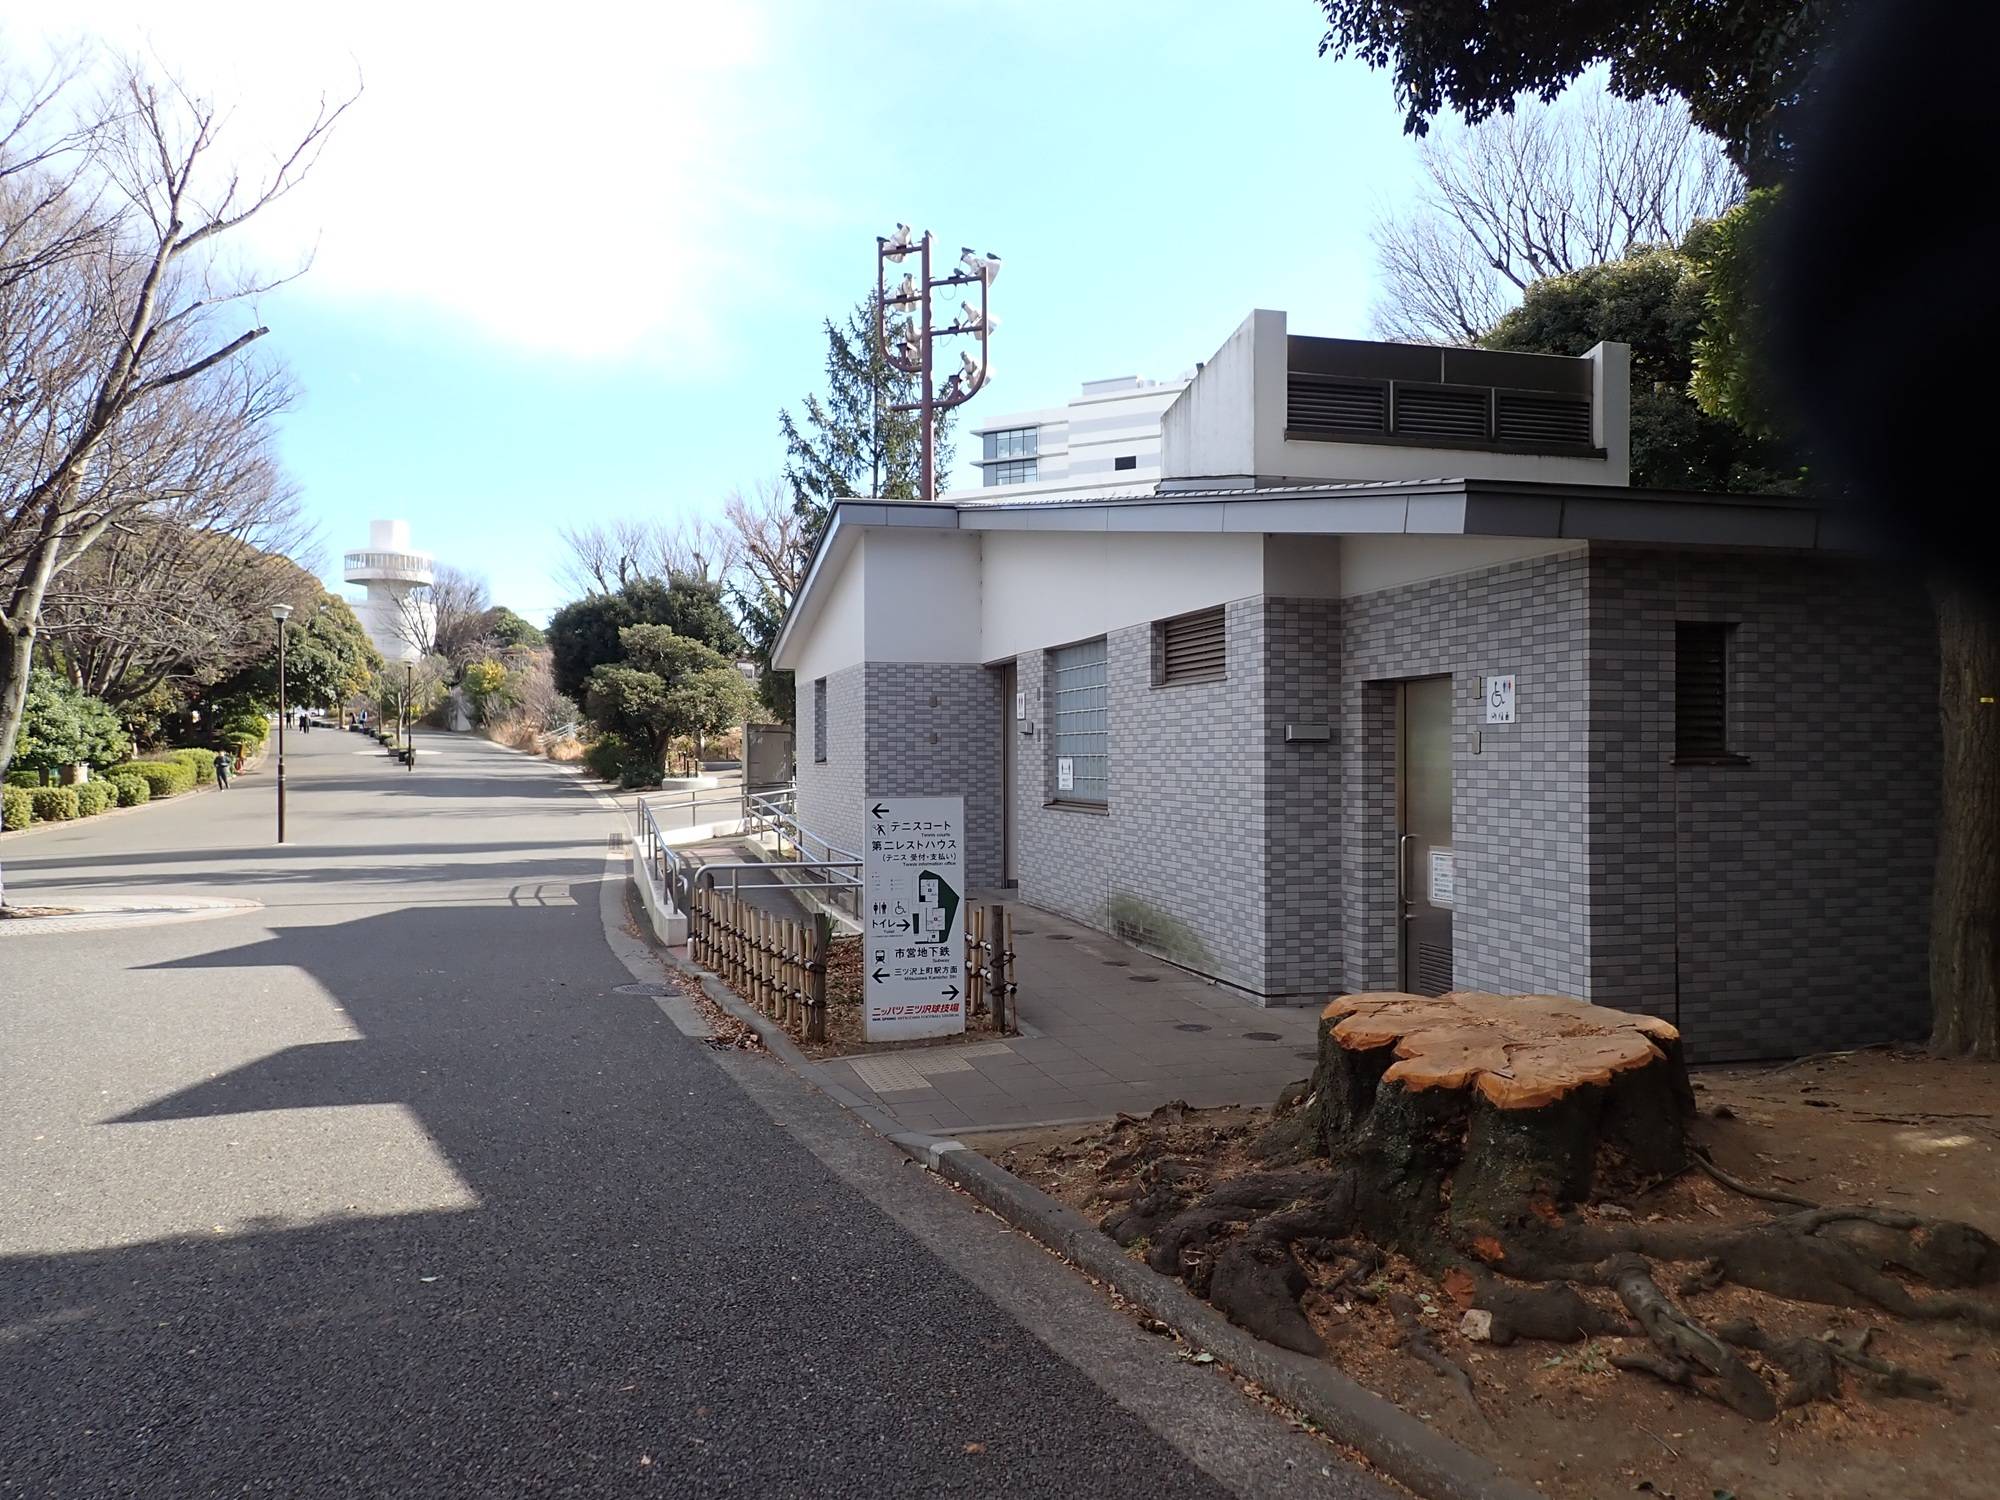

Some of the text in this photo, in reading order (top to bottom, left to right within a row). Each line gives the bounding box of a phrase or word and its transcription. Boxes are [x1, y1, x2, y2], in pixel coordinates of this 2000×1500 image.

[891, 820, 951, 832] テニスコート
[871, 840, 957, 851] 第二レストハウス
[872, 919, 896, 928] トイレ
[895, 946, 950, 959] 市営地下鉄
[894, 966, 958, 976] 三ツ沢上町駅方面
[872, 1006, 904, 1017] ニッパツ
